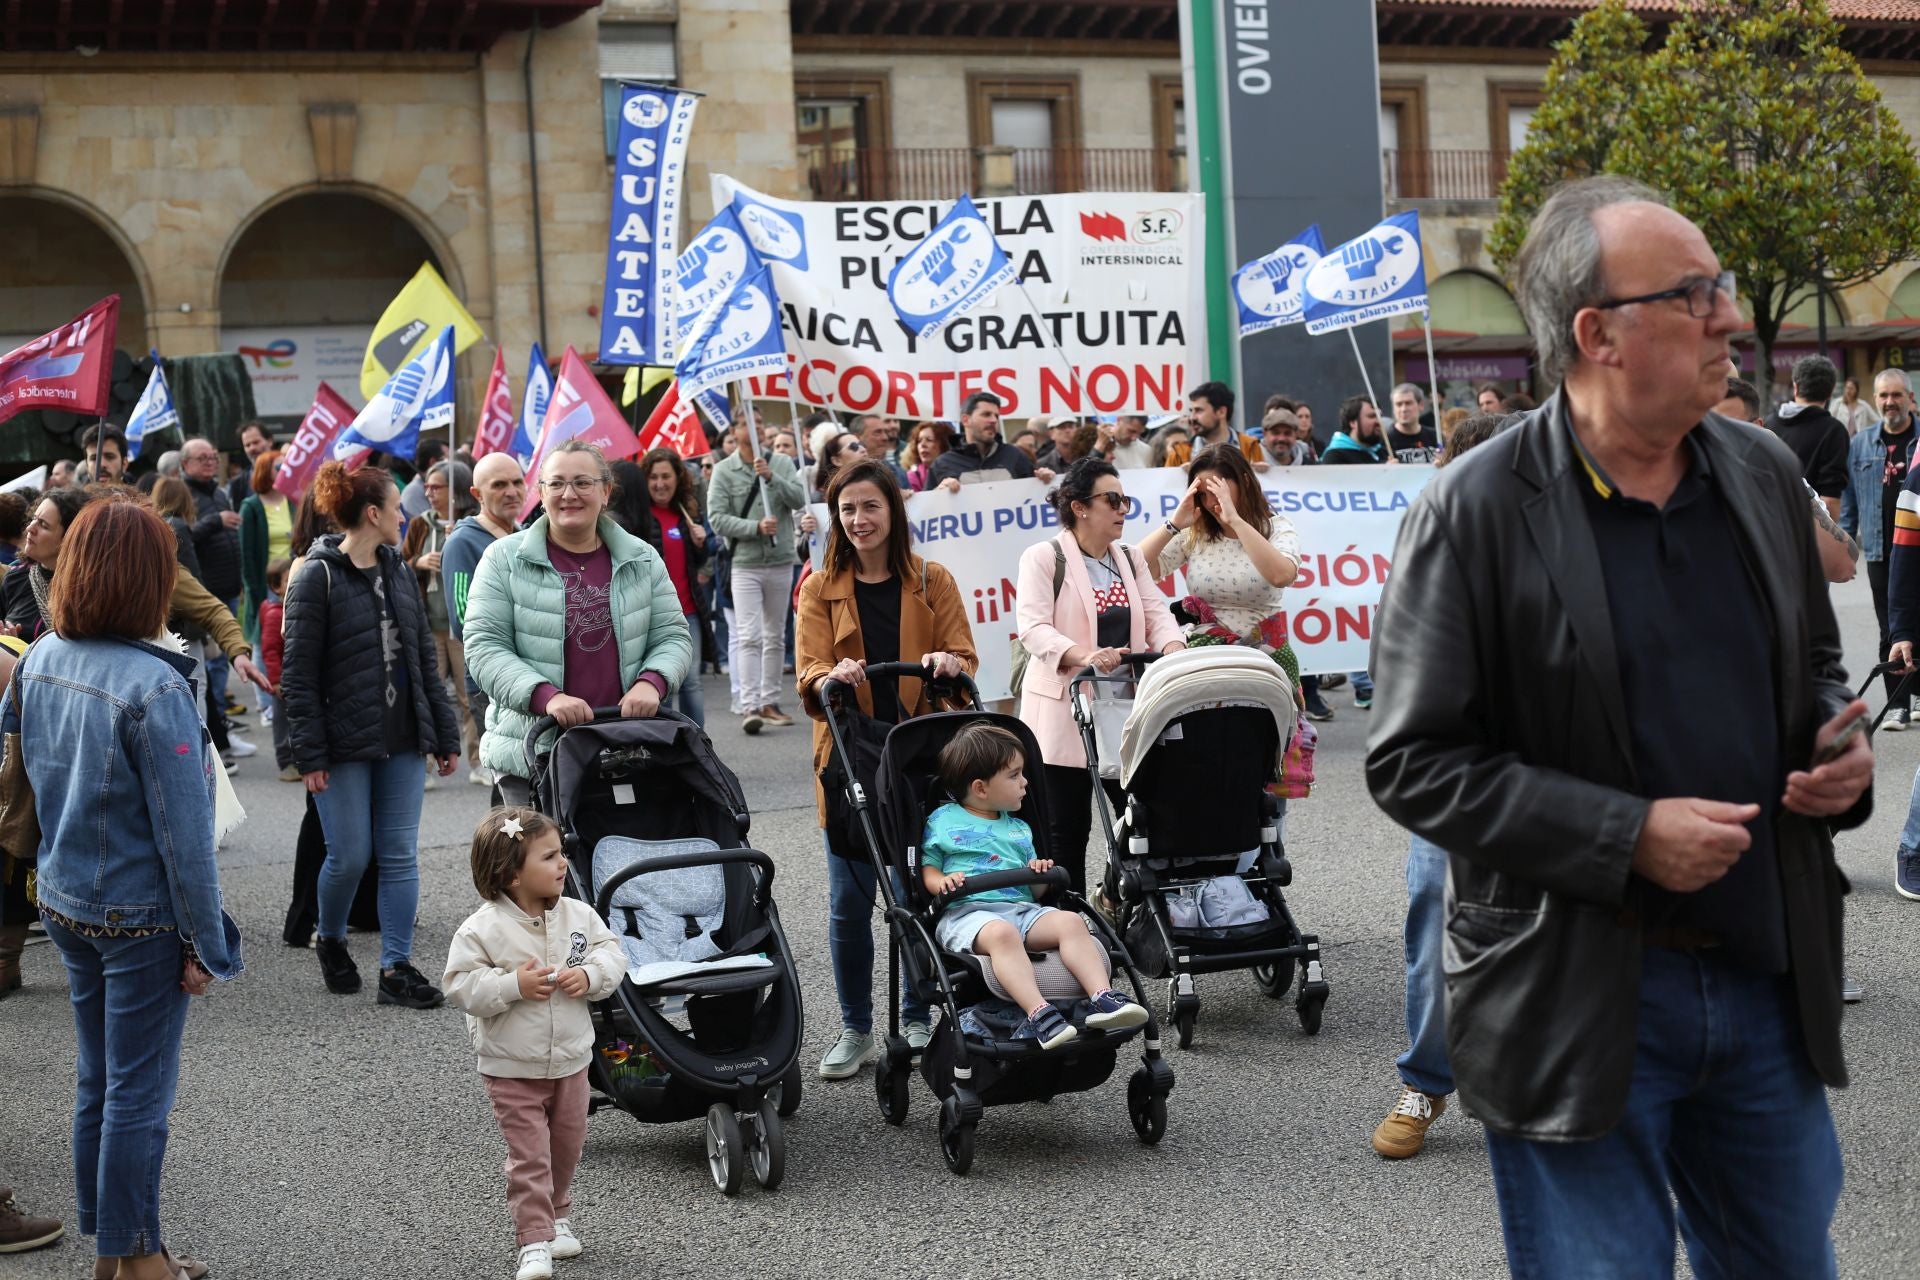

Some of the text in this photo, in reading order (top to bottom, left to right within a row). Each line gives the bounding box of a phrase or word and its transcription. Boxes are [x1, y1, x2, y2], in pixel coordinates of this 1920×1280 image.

[1234, 0, 1272, 95] OVIE
[609, 138, 656, 356] SUATEA
[661, 98, 693, 360] pola escuela pública
[1141, 218, 1172, 234] S.F.
[1081, 255, 1184, 265] INTERSINDICAL
[895, 319, 918, 354] Y
[944, 310, 1186, 353] GRATUITA
[748, 354, 1184, 418] ECORTES NON!
[911, 511, 983, 545] NERU
[1269, 490, 1410, 513] ESCUELA
[714, 1060, 759, 1072] baby jogger
